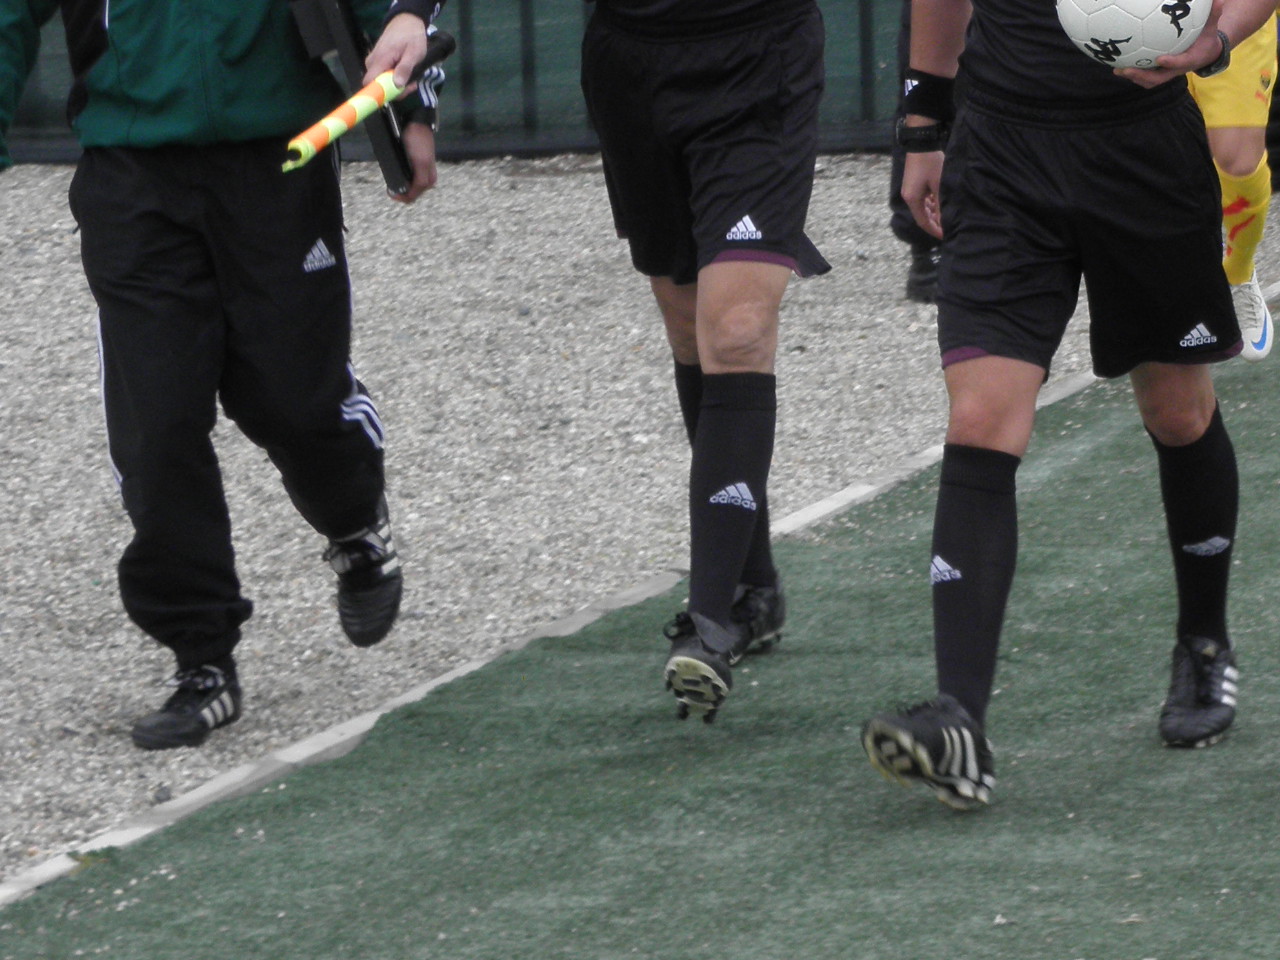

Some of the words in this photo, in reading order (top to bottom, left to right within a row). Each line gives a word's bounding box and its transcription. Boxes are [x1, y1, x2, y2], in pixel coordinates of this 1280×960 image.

[726, 229, 763, 241] adidas
[1179, 335, 1218, 347] adidas
[709, 495, 757, 511] adidas
